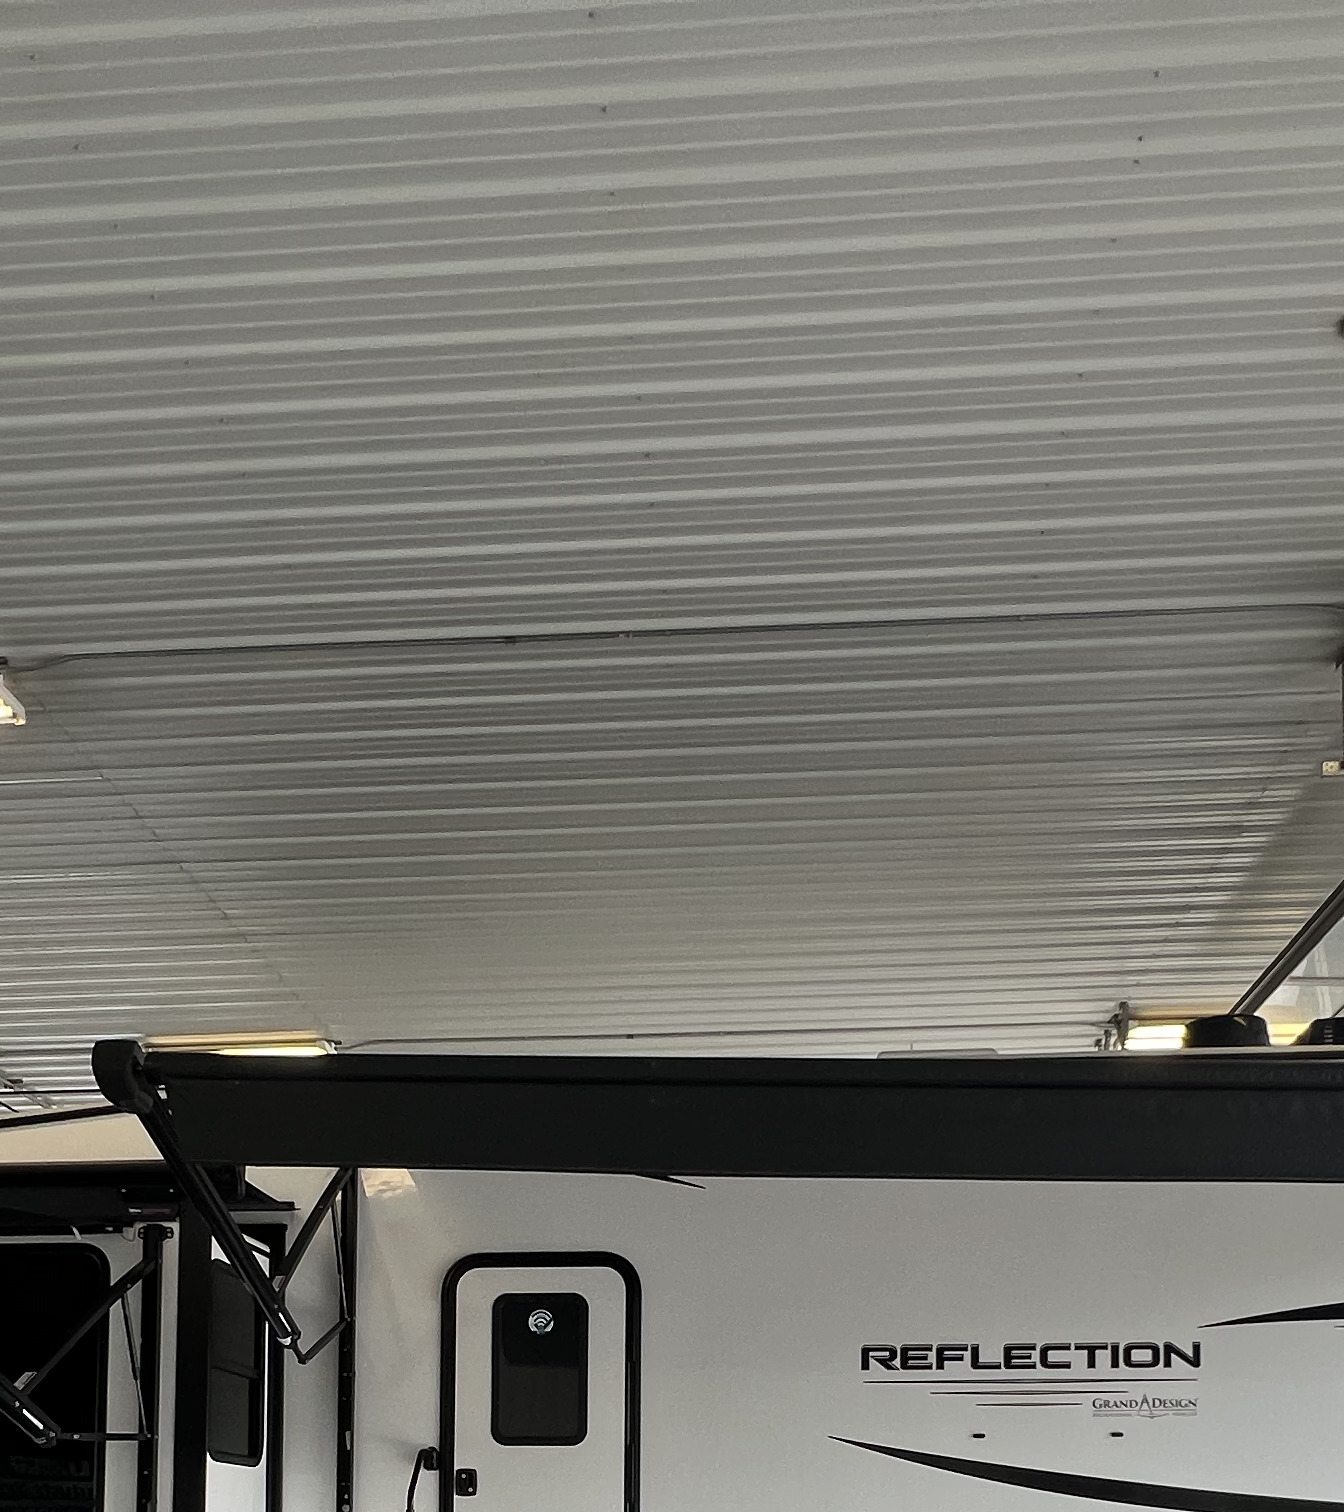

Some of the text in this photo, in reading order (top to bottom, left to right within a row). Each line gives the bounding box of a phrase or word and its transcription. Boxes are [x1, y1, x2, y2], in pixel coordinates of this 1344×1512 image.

[860, 1341, 1201, 1371] REFLECTION
[1092, 1397, 1198, 1409] GRAND DESIGN
